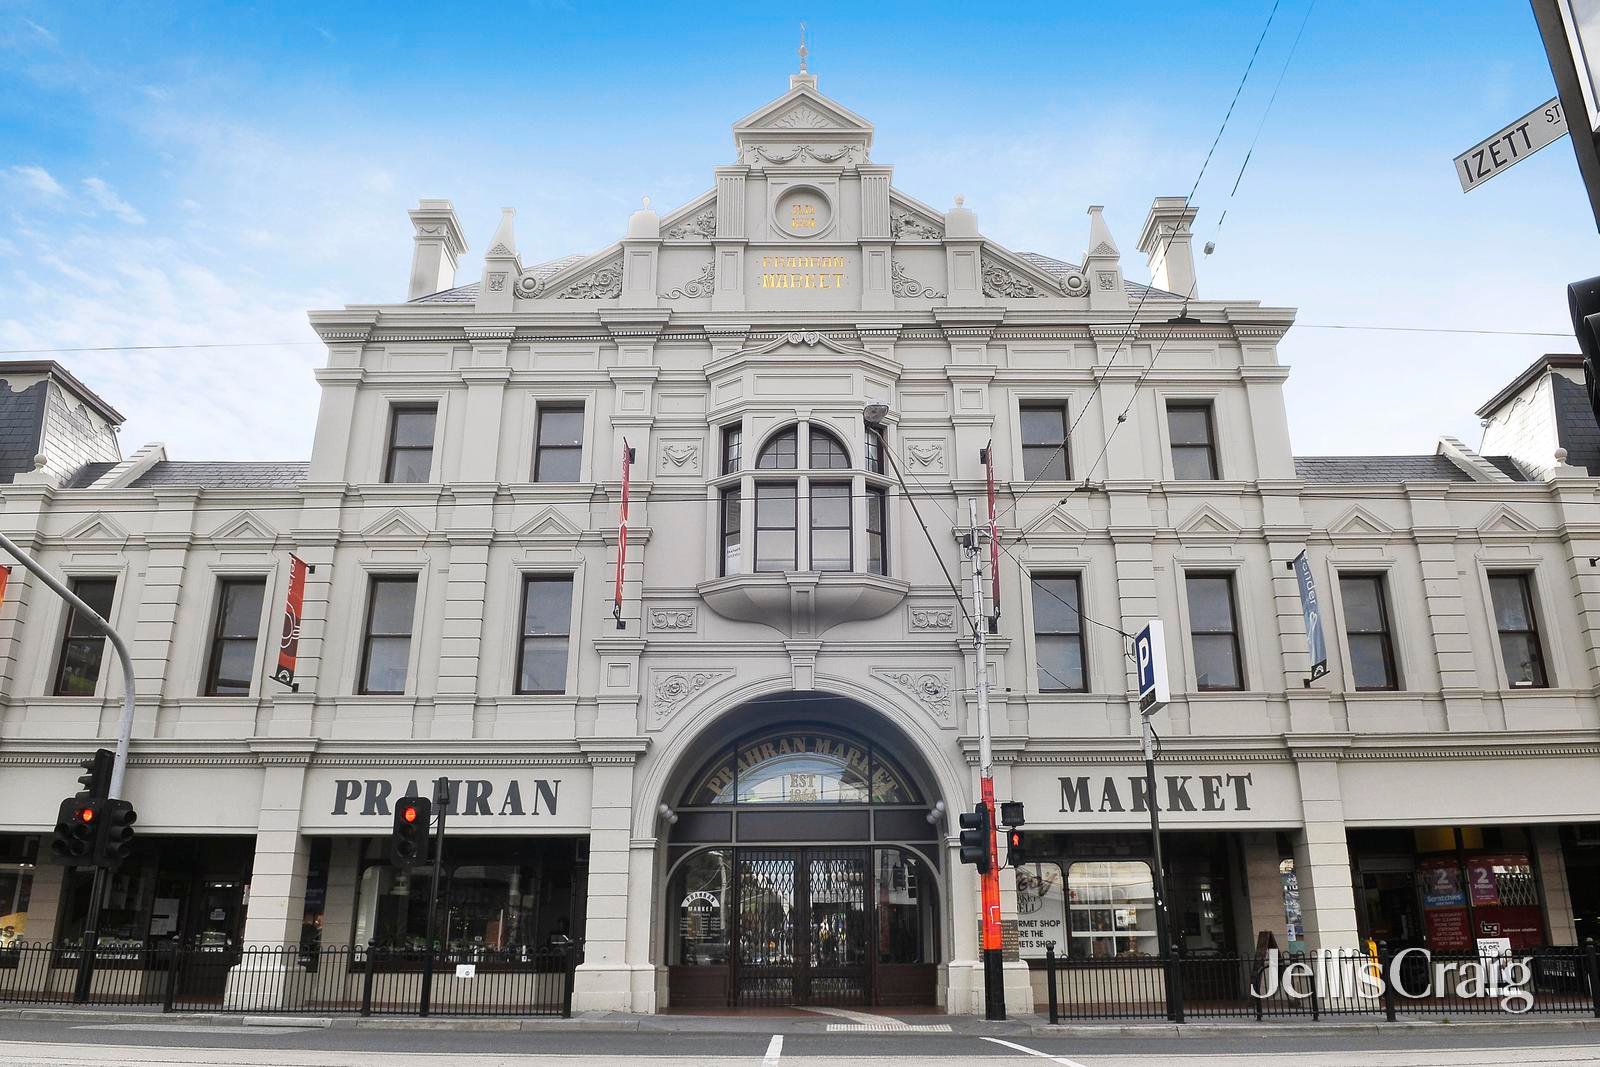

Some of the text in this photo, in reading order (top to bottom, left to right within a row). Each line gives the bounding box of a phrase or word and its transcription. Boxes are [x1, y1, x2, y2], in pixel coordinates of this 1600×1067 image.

[1463, 103, 1561, 183] IZETT ST
[763, 256, 845, 268] PRAHRAN
[763, 273, 844, 288] MARKET
[1138, 637, 1150, 686] P
[707, 736, 898, 797] PRAHRAN MARKET
[790, 773, 816, 788] EST
[1058, 772, 1253, 812] MARKET
[1474, 867, 1489, 883] 2
[1039, 919, 1061, 927] SHOP
[1480, 921, 1501, 937] tsg
[1030, 930, 1044, 938] THE
